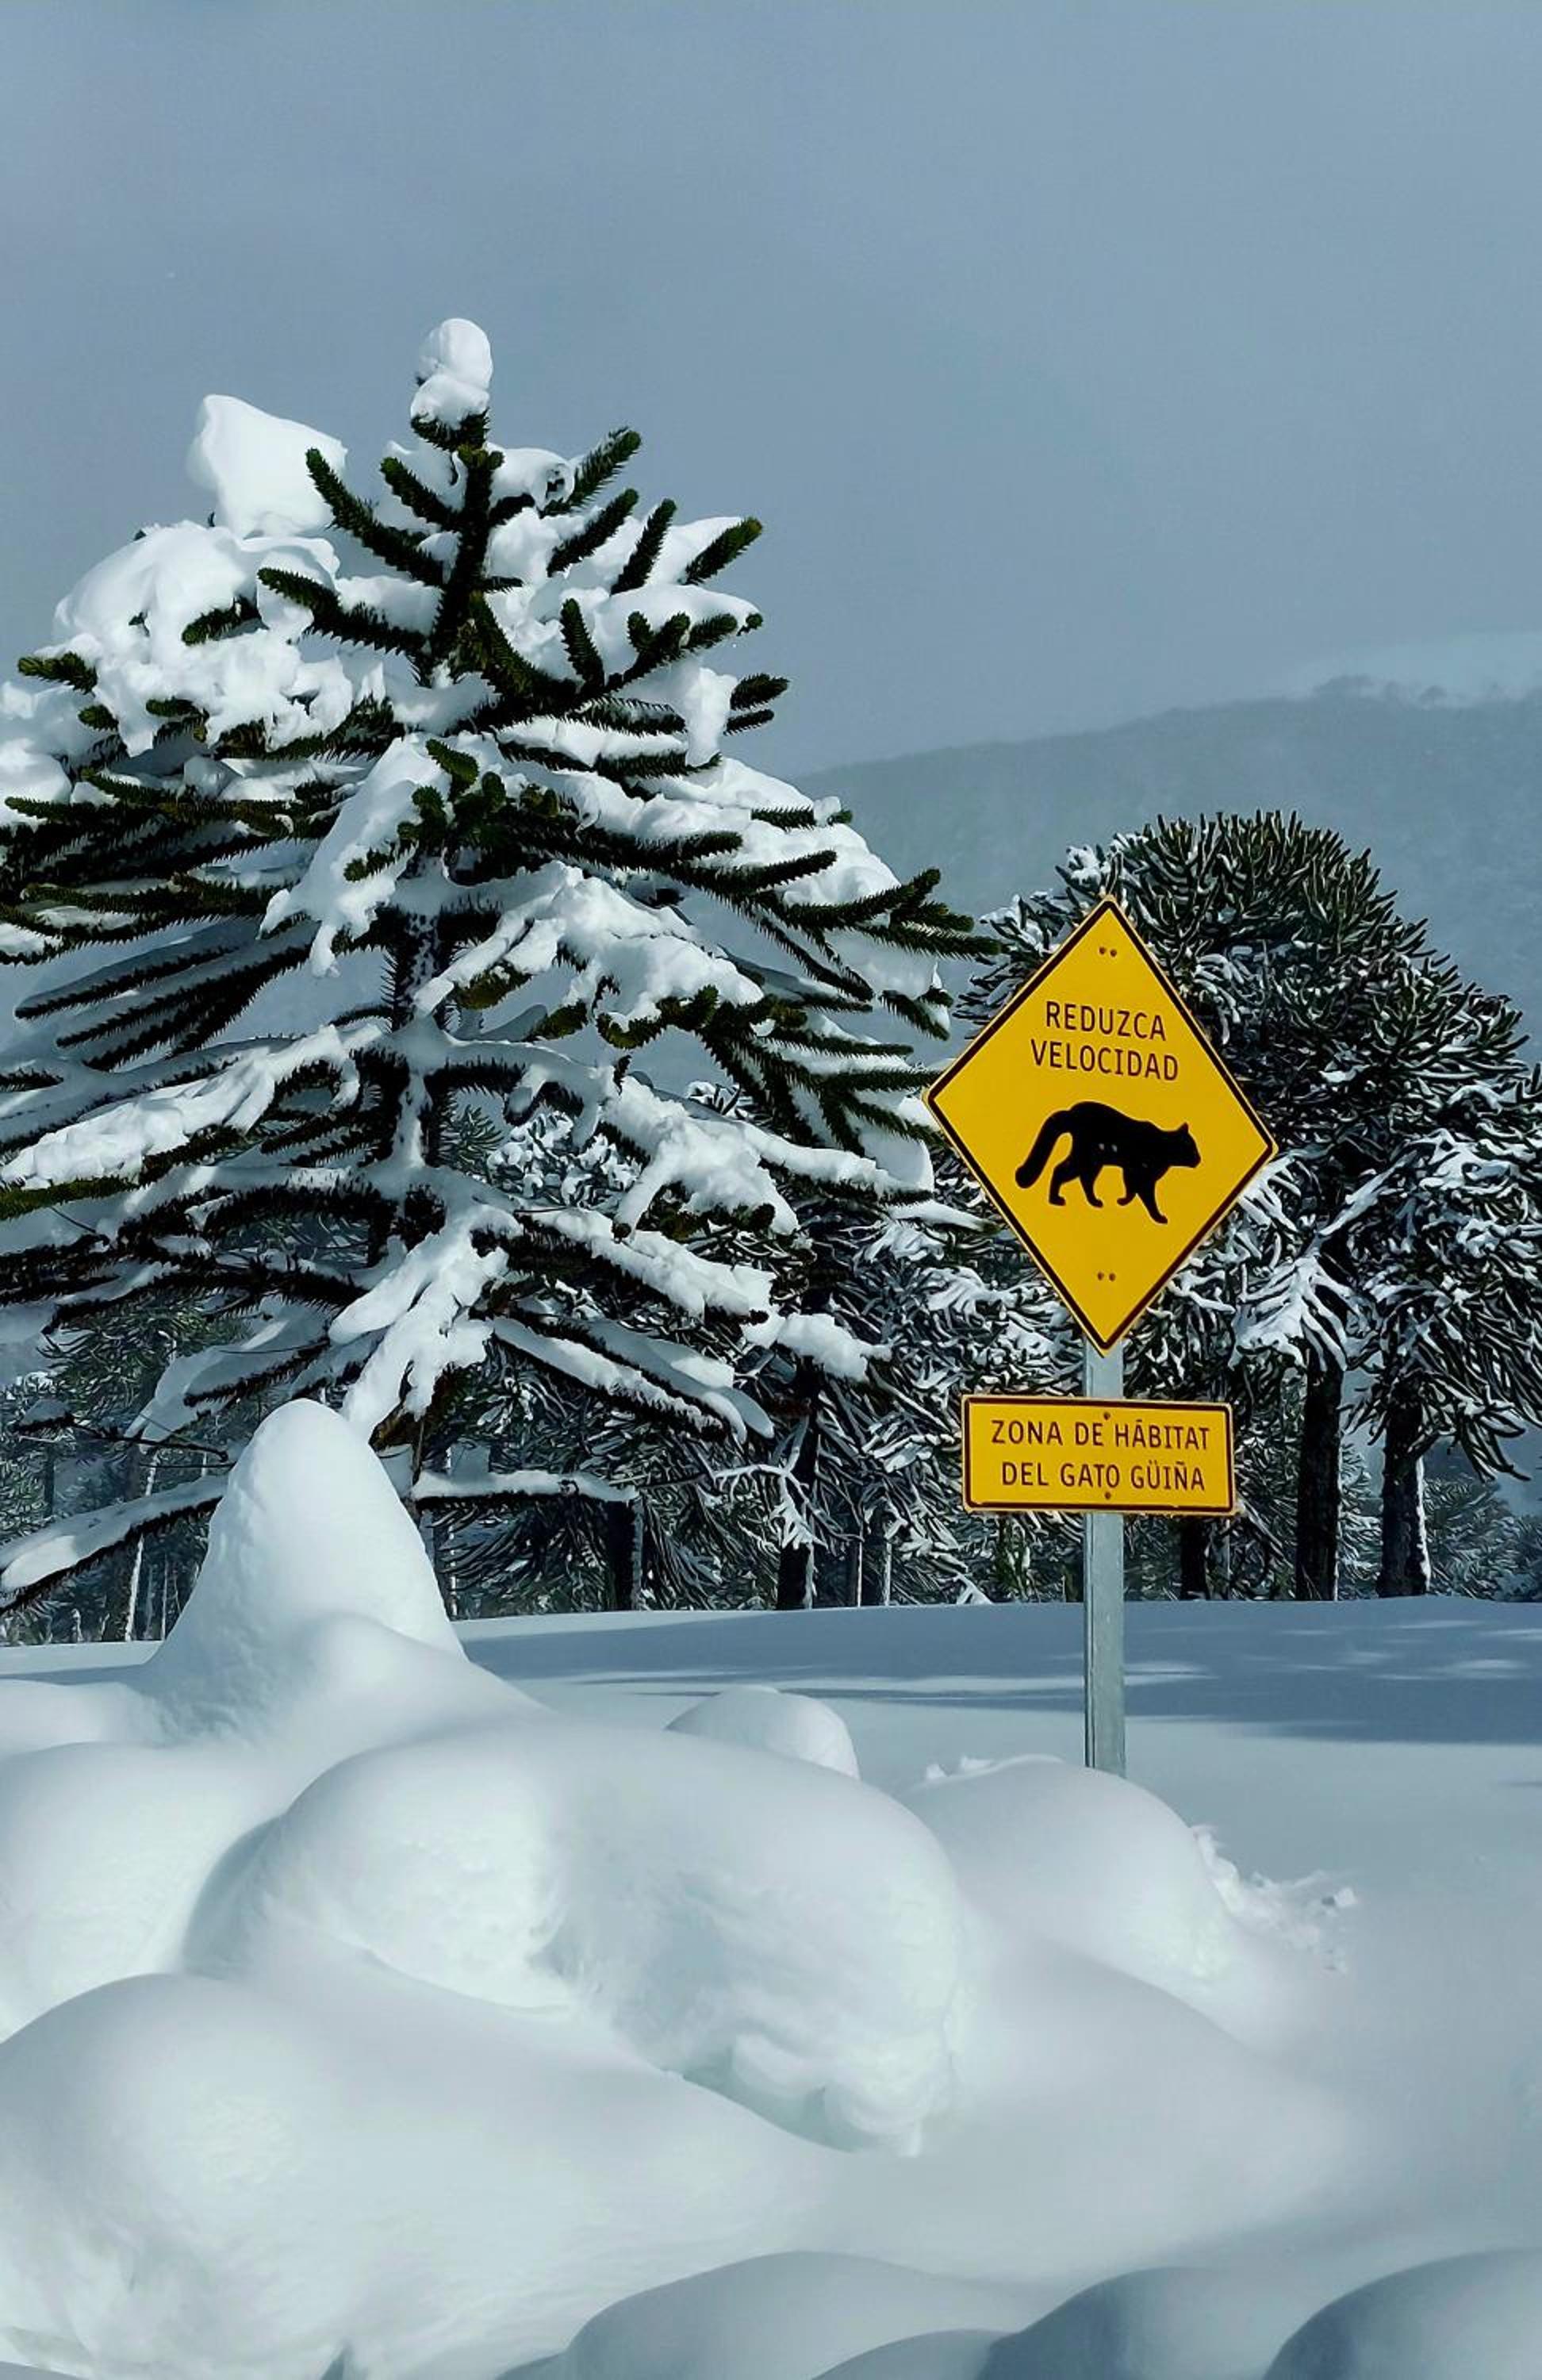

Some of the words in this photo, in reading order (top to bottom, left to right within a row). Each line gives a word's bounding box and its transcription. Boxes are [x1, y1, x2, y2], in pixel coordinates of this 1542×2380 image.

[1045, 1000, 1166, 1041] REDUZCA
[1030, 1038, 1179, 1081] VELOCIDAD
[991, 1419, 1063, 1445] ZONA
[1075, 1422, 1103, 1445] DE
[1114, 1419, 1210, 1450] HÁBITAT
[1002, 1461, 1049, 1486] DEL
[1060, 1463, 1120, 1488] GATO
[1130, 1460, 1205, 1491] GÜIÑA
